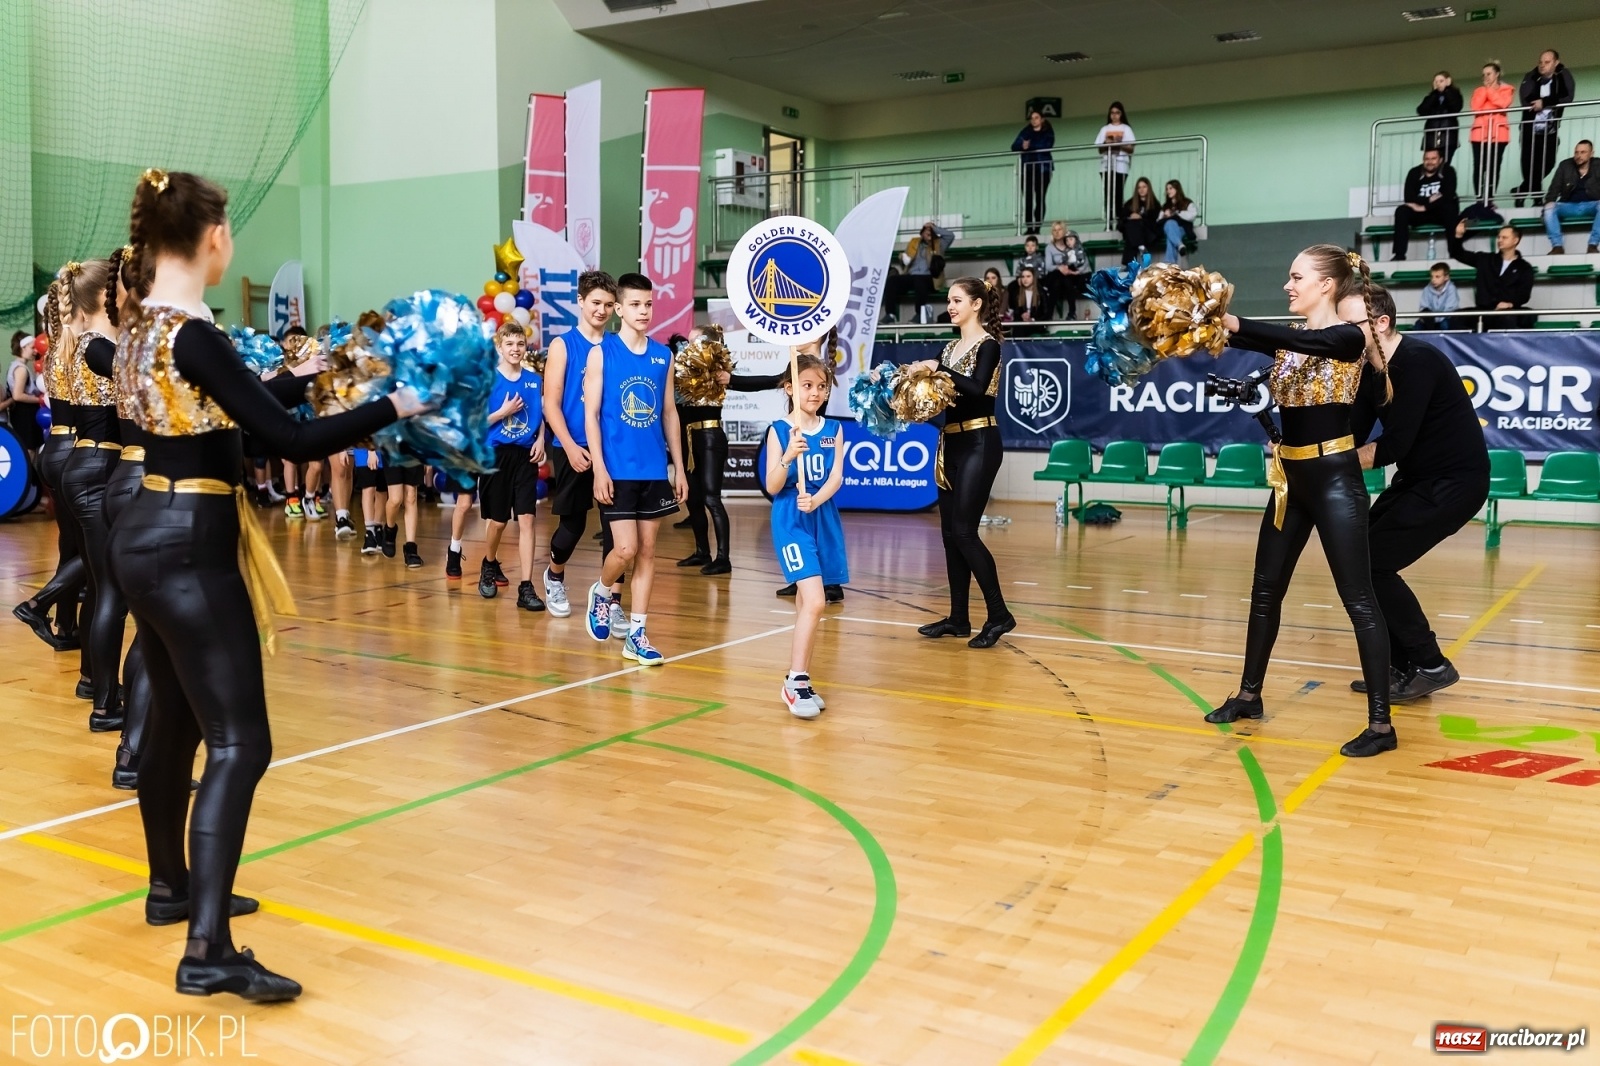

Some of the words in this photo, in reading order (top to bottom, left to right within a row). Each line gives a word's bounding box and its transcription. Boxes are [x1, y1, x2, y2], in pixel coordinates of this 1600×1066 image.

[748, 226, 795, 252] GOLDEN
[799, 229, 831, 256] STATE
[861, 267, 882, 336] RACIBÓRZ
[744, 302, 831, 336] WARRIORS
[740, 351, 780, 360] UMOWY
[620, 375, 642, 389] GOLDEN
[1455, 365, 1593, 413] OSiR
[1497, 413, 1592, 431] RACIBÓRZ
[806, 453, 825, 481] 19
[845, 476, 859, 486] the
[860, 477, 872, 486] Jr.
[873, 477, 893, 486] NBA
[895, 477, 928, 489] League
[782, 542, 804, 573] 19
